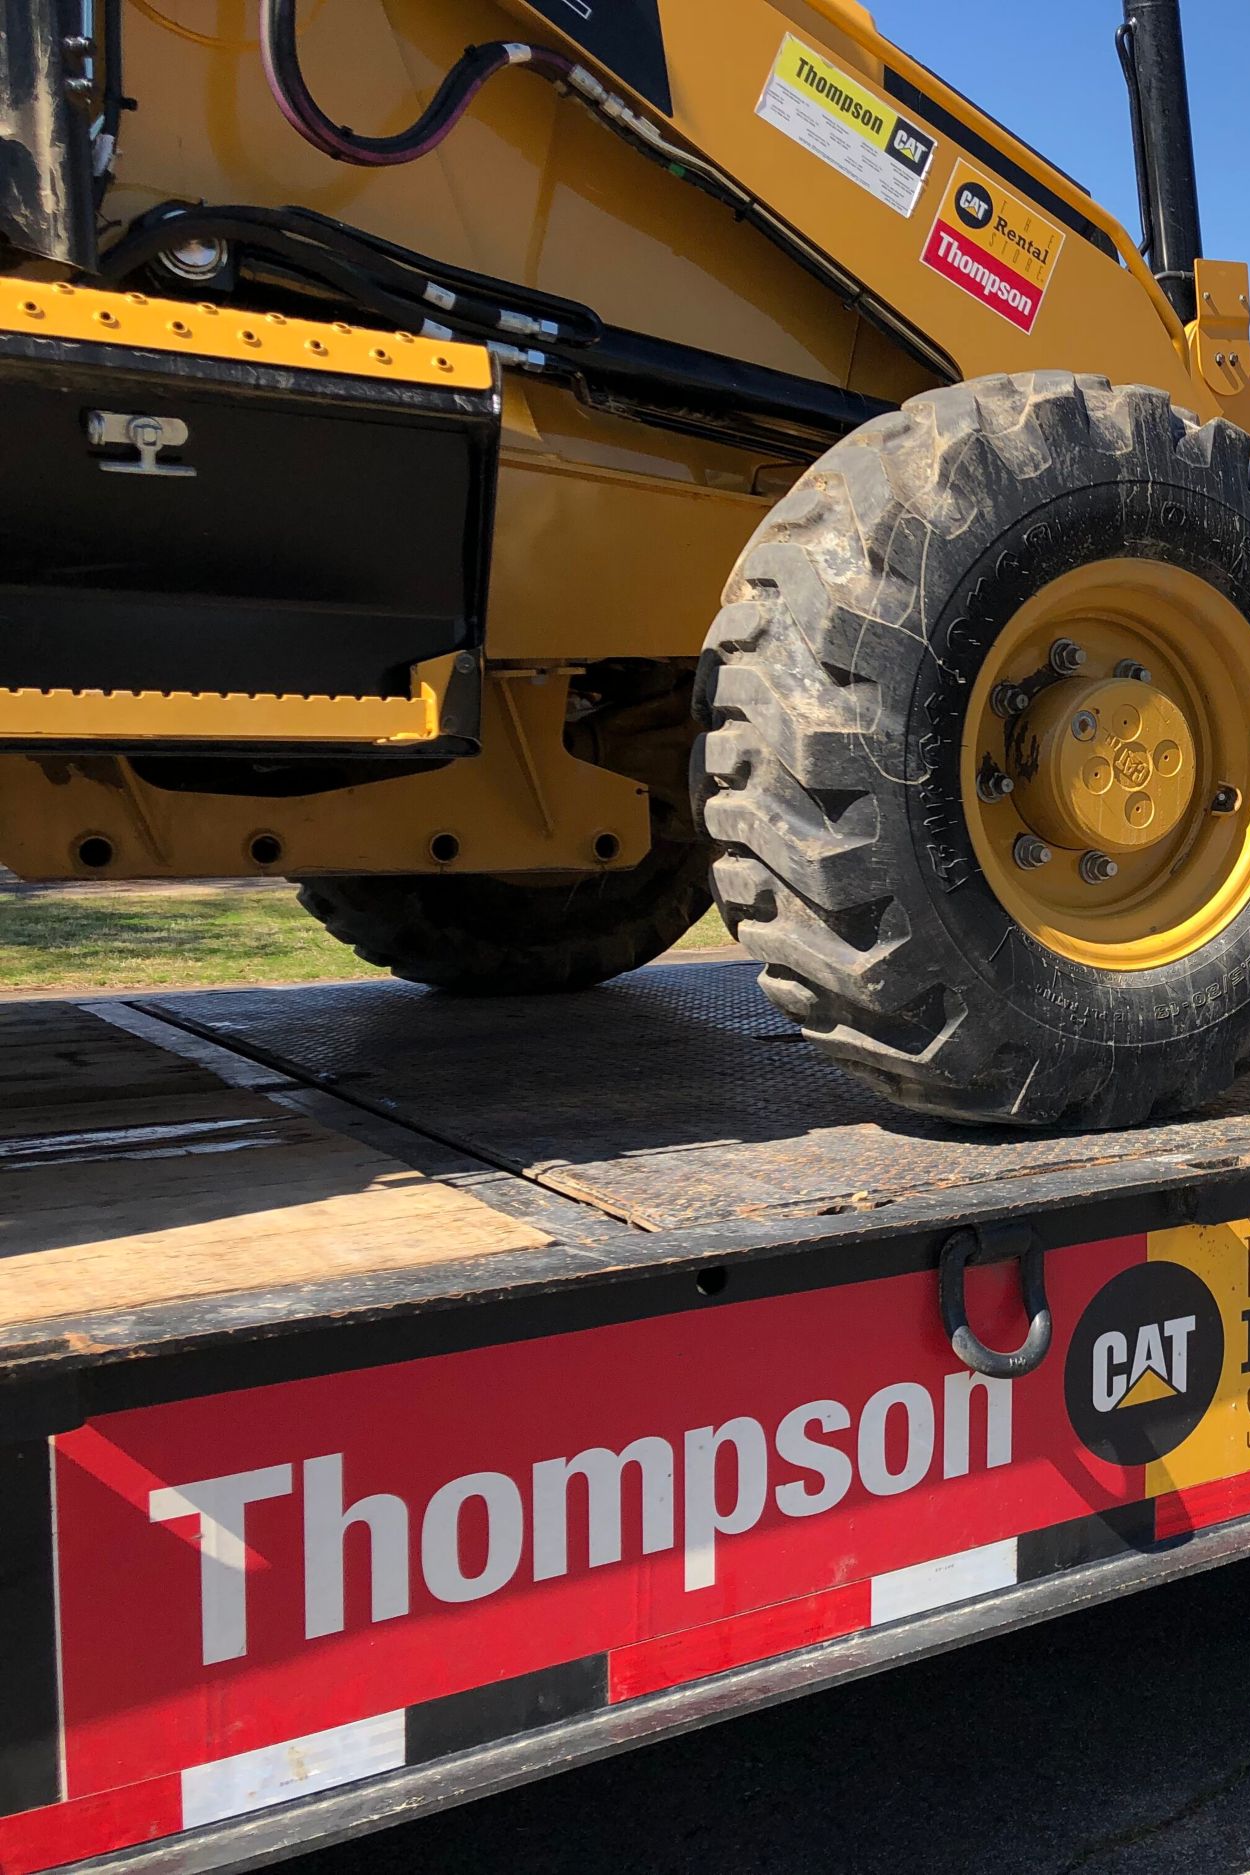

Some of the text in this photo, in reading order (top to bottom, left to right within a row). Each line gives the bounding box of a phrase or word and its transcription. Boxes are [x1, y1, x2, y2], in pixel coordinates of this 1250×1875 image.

[795, 56, 884, 136] Thompson
[893, 129, 928, 166] CAT
[959, 189, 989, 221] CAT
[993, 215, 1051, 266] Rental
[937, 231, 1032, 316] Thompson
[1091, 1314, 1196, 1413] CAT
[148, 1372, 1015, 1667] Thompson
